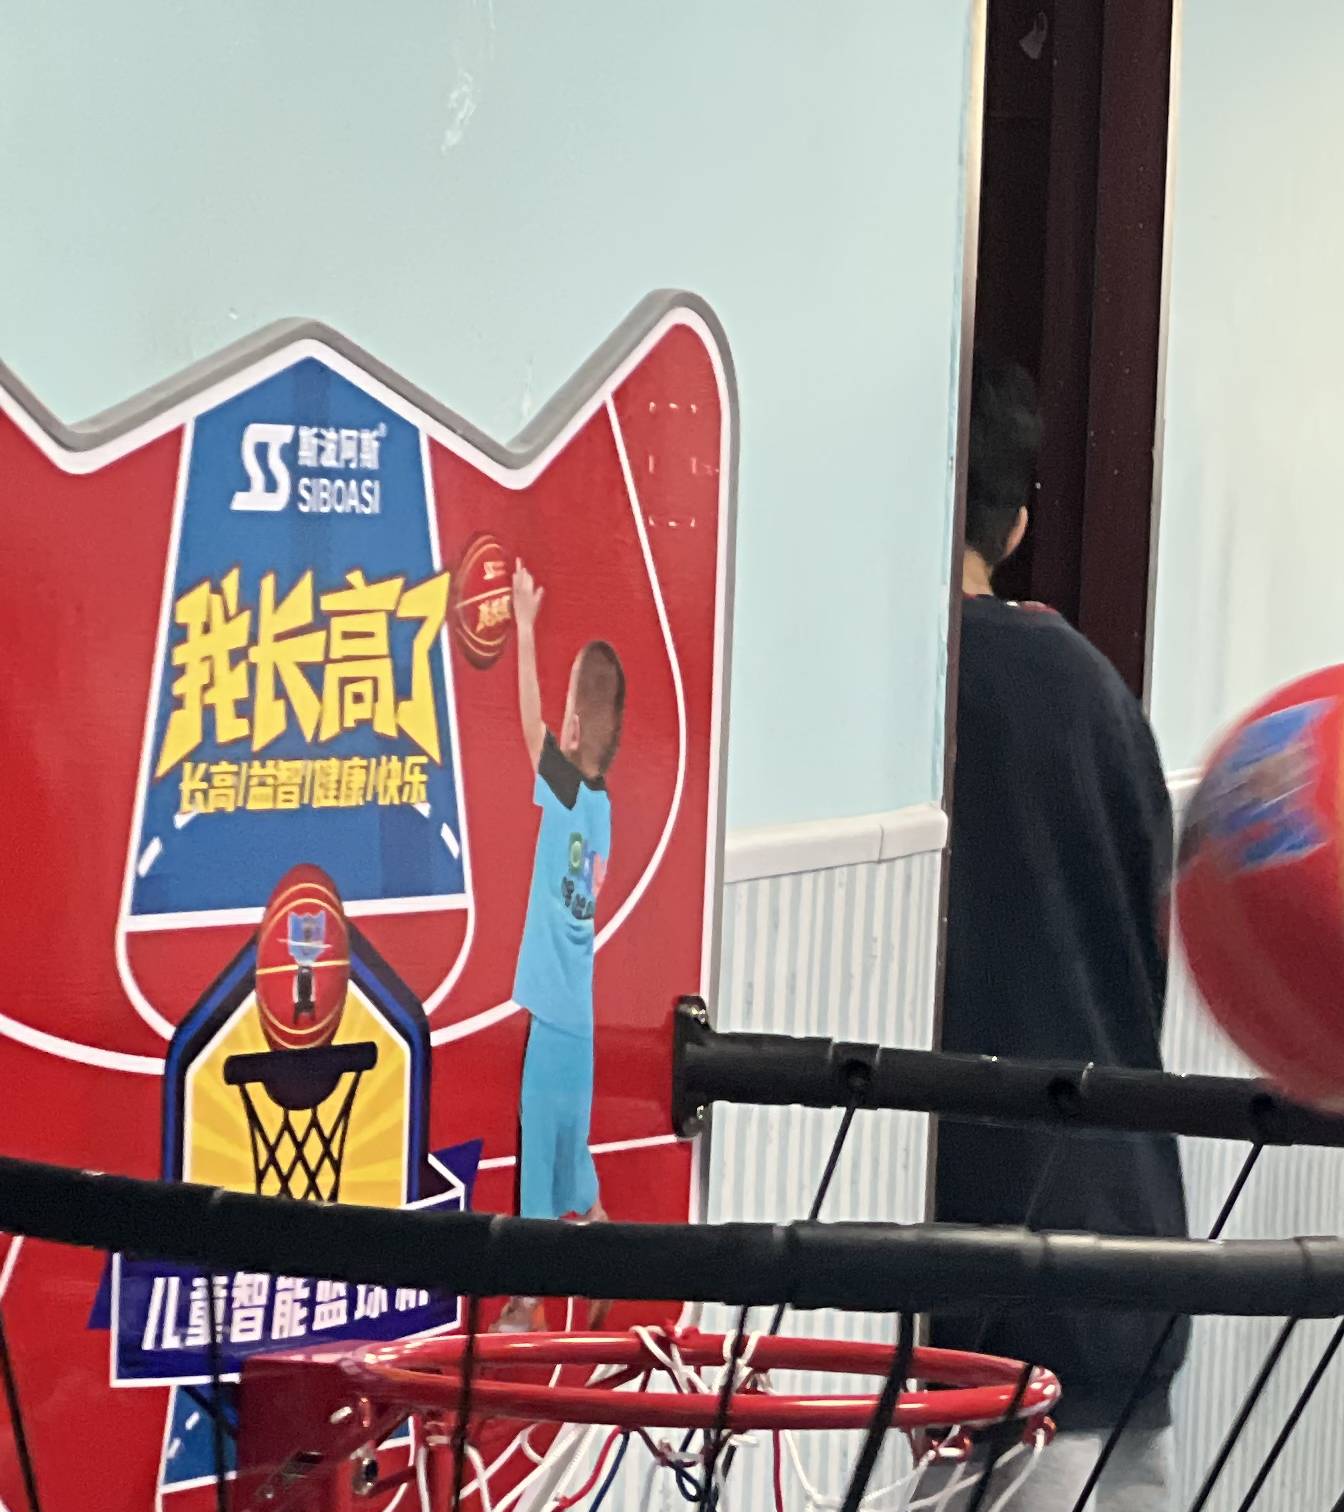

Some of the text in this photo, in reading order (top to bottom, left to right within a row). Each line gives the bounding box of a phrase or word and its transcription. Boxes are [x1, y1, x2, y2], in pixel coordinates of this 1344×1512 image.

[298, 477, 381, 514] SIBOASI
[154, 566, 450, 779] 我长高了
